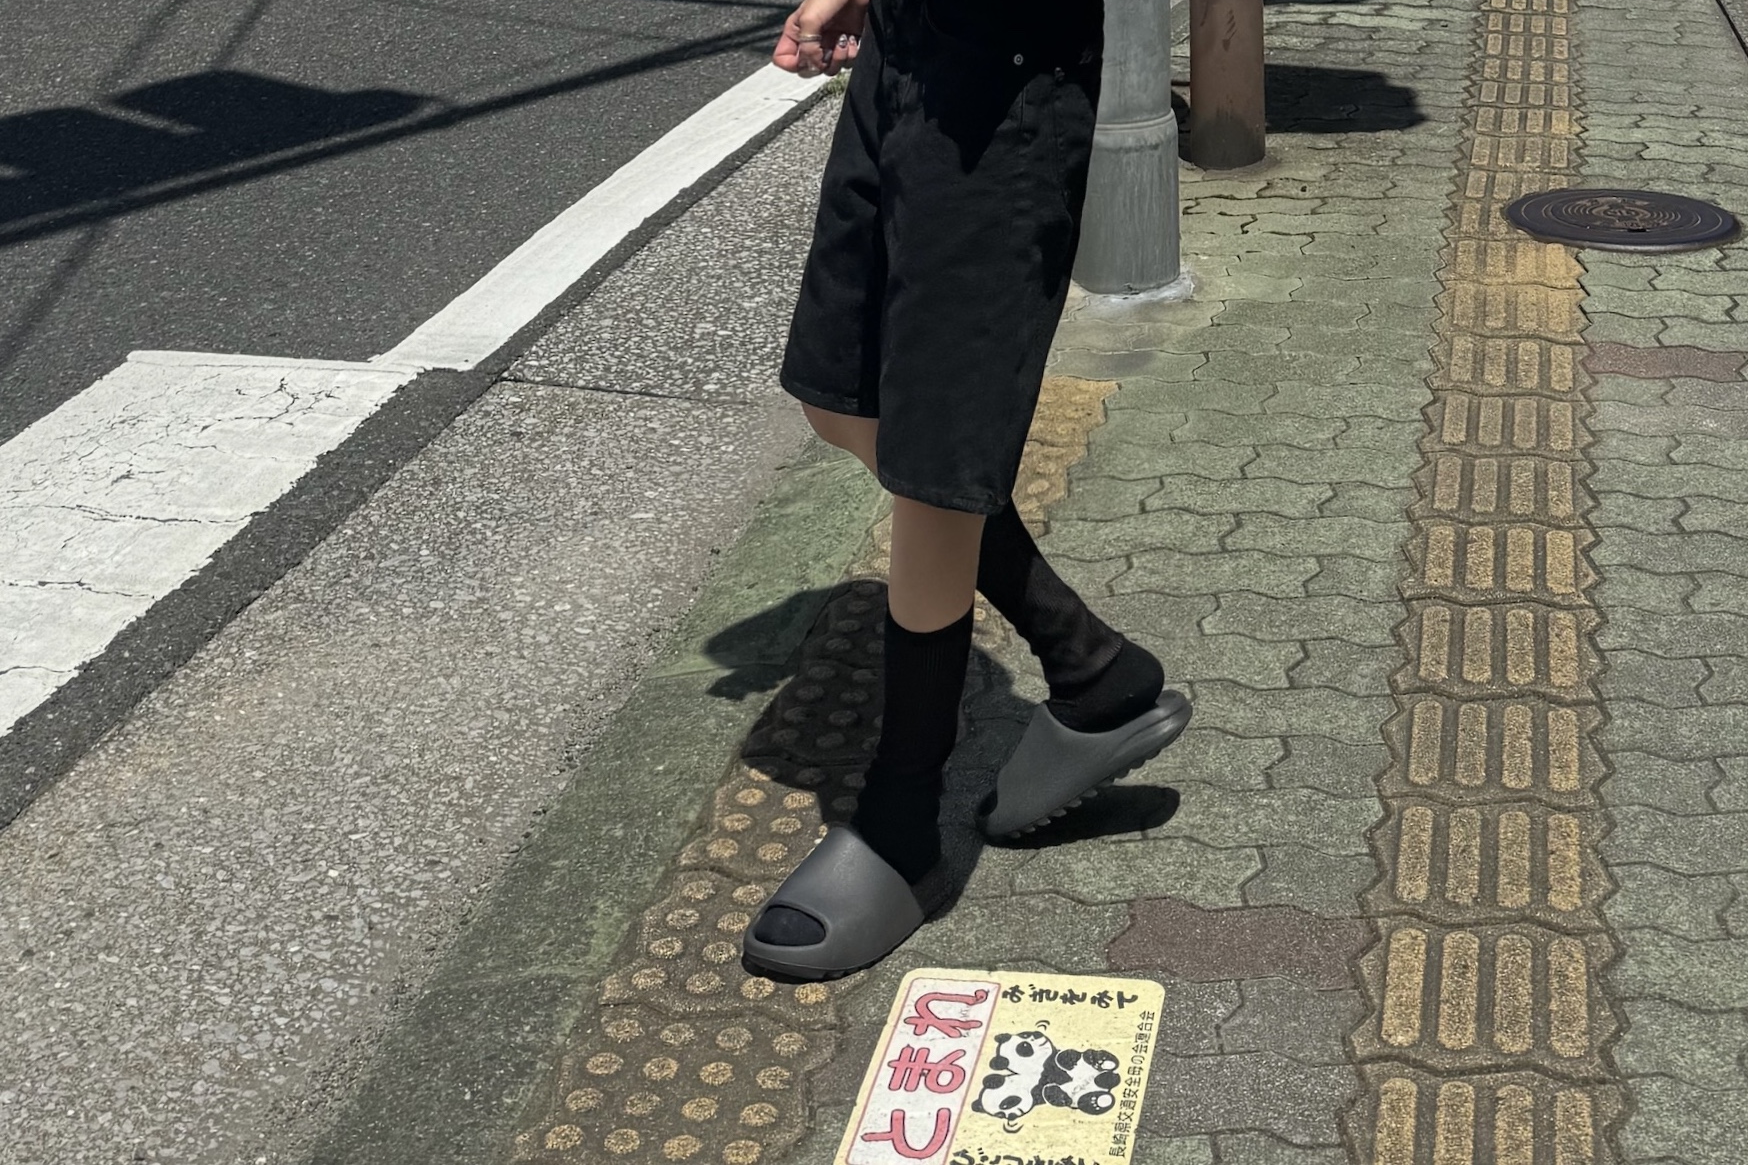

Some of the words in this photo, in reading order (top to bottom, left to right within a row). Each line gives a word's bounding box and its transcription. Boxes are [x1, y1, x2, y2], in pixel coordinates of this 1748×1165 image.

[1001, 984, 1138, 1009] みぎをみて
[861, 988, 988, 1159] とまれ
[1109, 1010, 1155, 1159] 長崎県交通安全母の会連合会
